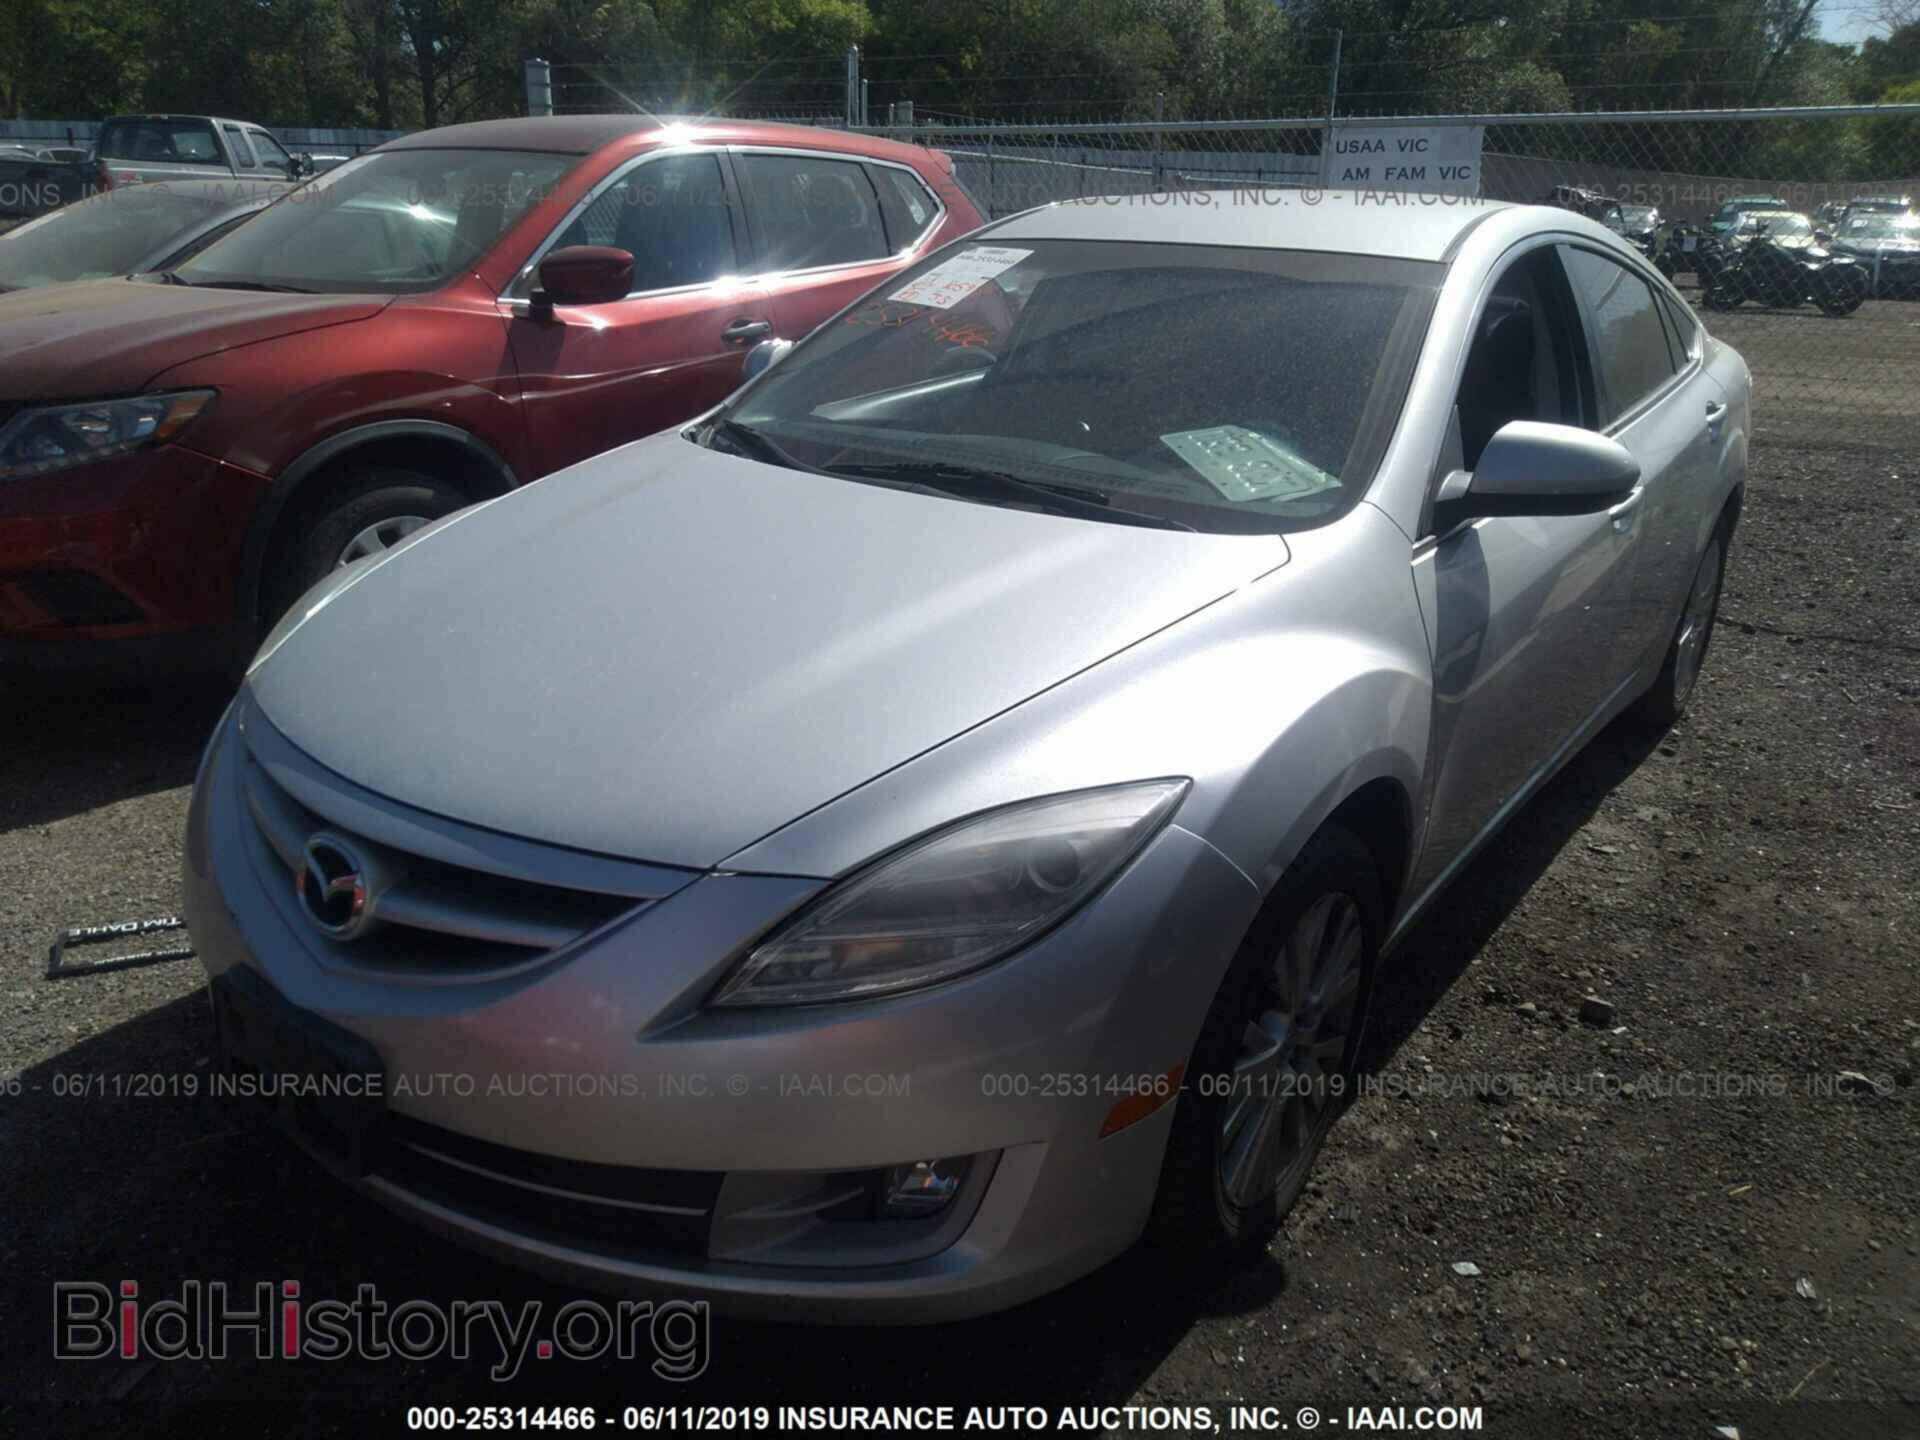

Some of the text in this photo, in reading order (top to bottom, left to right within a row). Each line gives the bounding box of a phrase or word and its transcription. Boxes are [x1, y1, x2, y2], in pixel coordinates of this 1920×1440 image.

[1336, 138, 1429, 154] USAA VIC
[1341, 166, 1471, 181] AM FAM VIC
